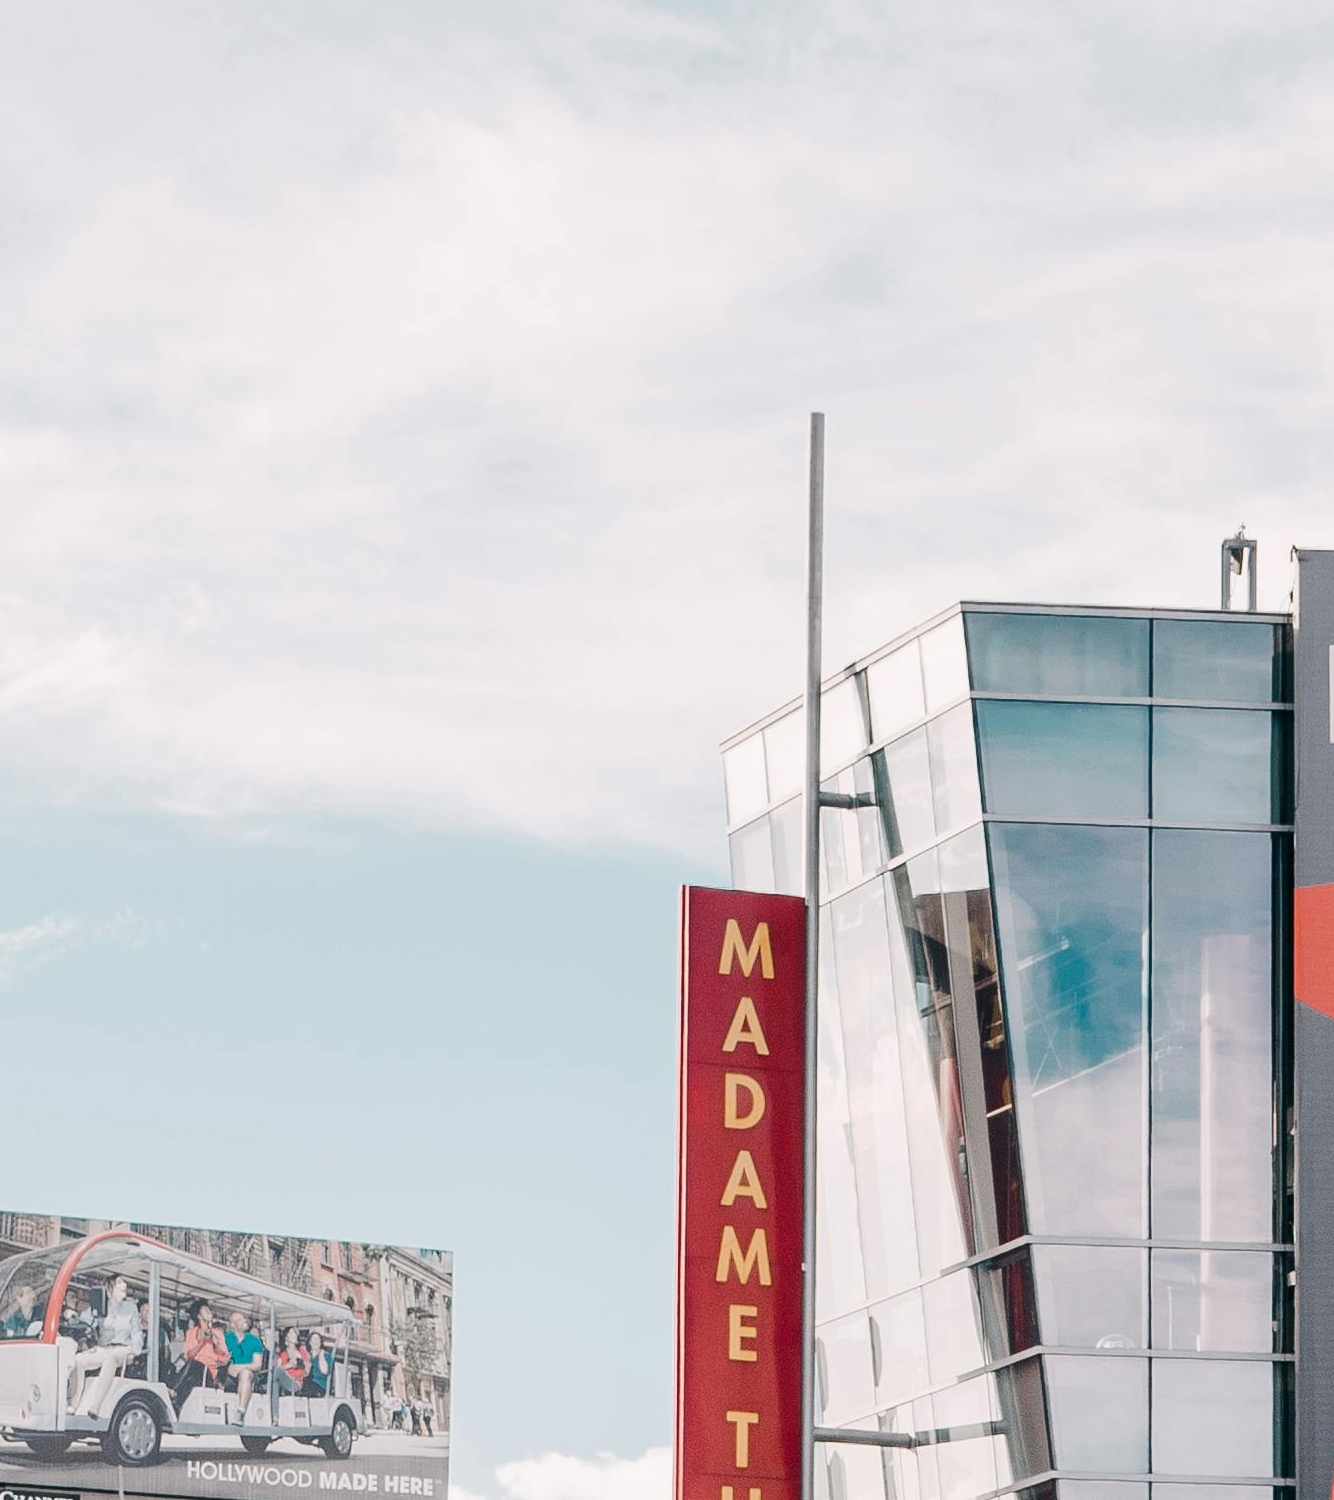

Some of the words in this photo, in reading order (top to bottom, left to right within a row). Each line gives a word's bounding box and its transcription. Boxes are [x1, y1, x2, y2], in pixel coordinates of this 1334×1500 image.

[718, 919, 774, 1361] MADAME
[187, 1460, 312, 1487] HOLLYWOOD
[319, 1471, 378, 1491] MADE
